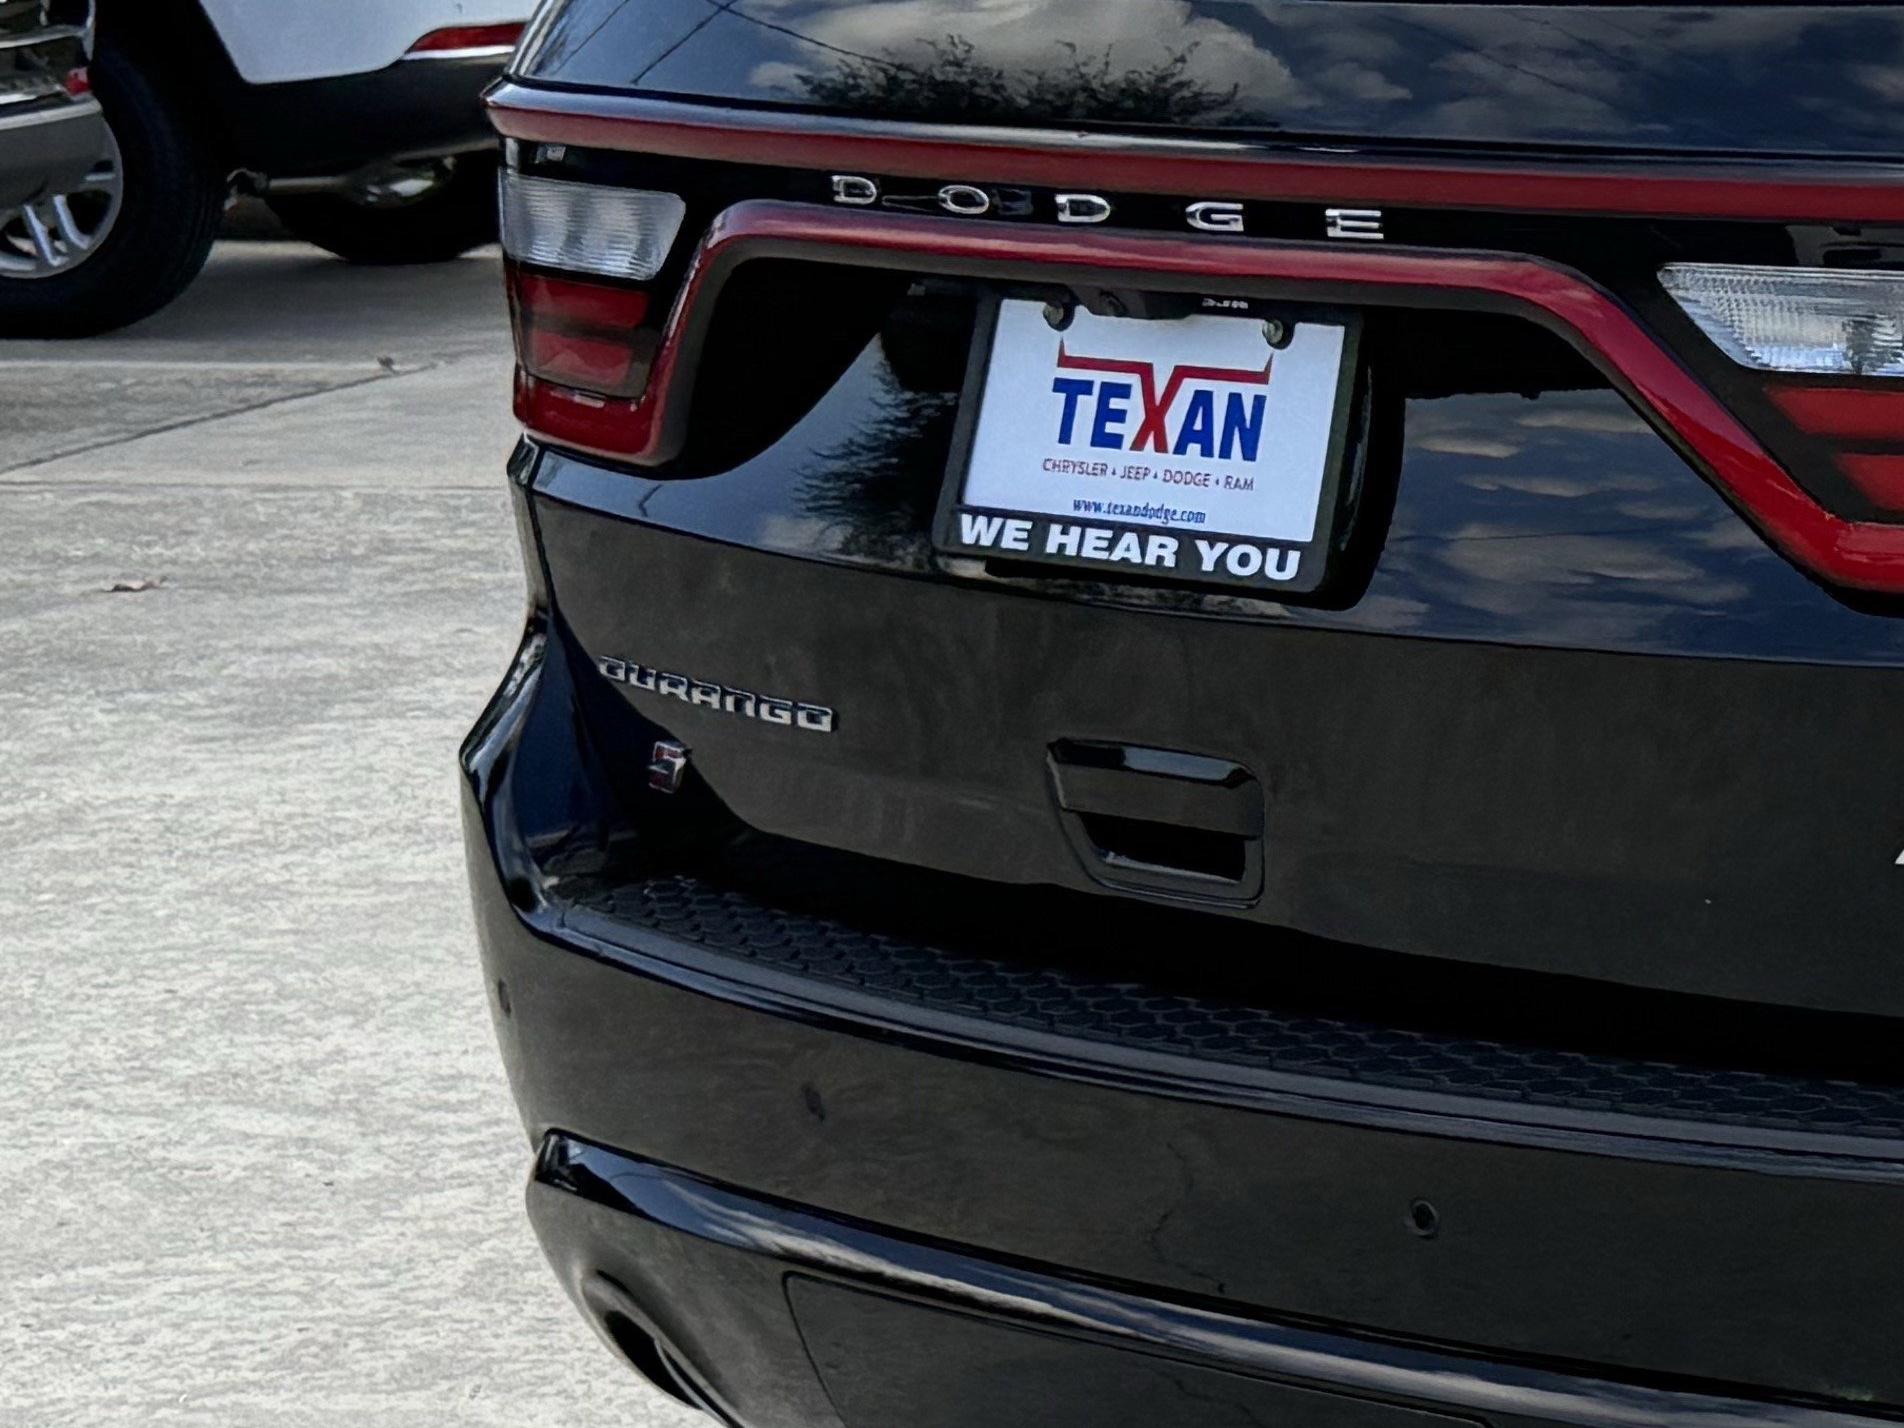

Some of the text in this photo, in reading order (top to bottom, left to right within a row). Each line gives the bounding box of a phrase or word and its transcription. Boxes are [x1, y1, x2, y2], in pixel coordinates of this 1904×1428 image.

[831, 174, 1384, 240] DODGE
[1051, 336, 1273, 462] TEXAN
[1042, 458, 1254, 491] CHRYSLER JEEP DODGE RAM
[1072, 498, 1206, 524] www.texandodge.com
[959, 514, 1301, 581] WE HEAR YOU
